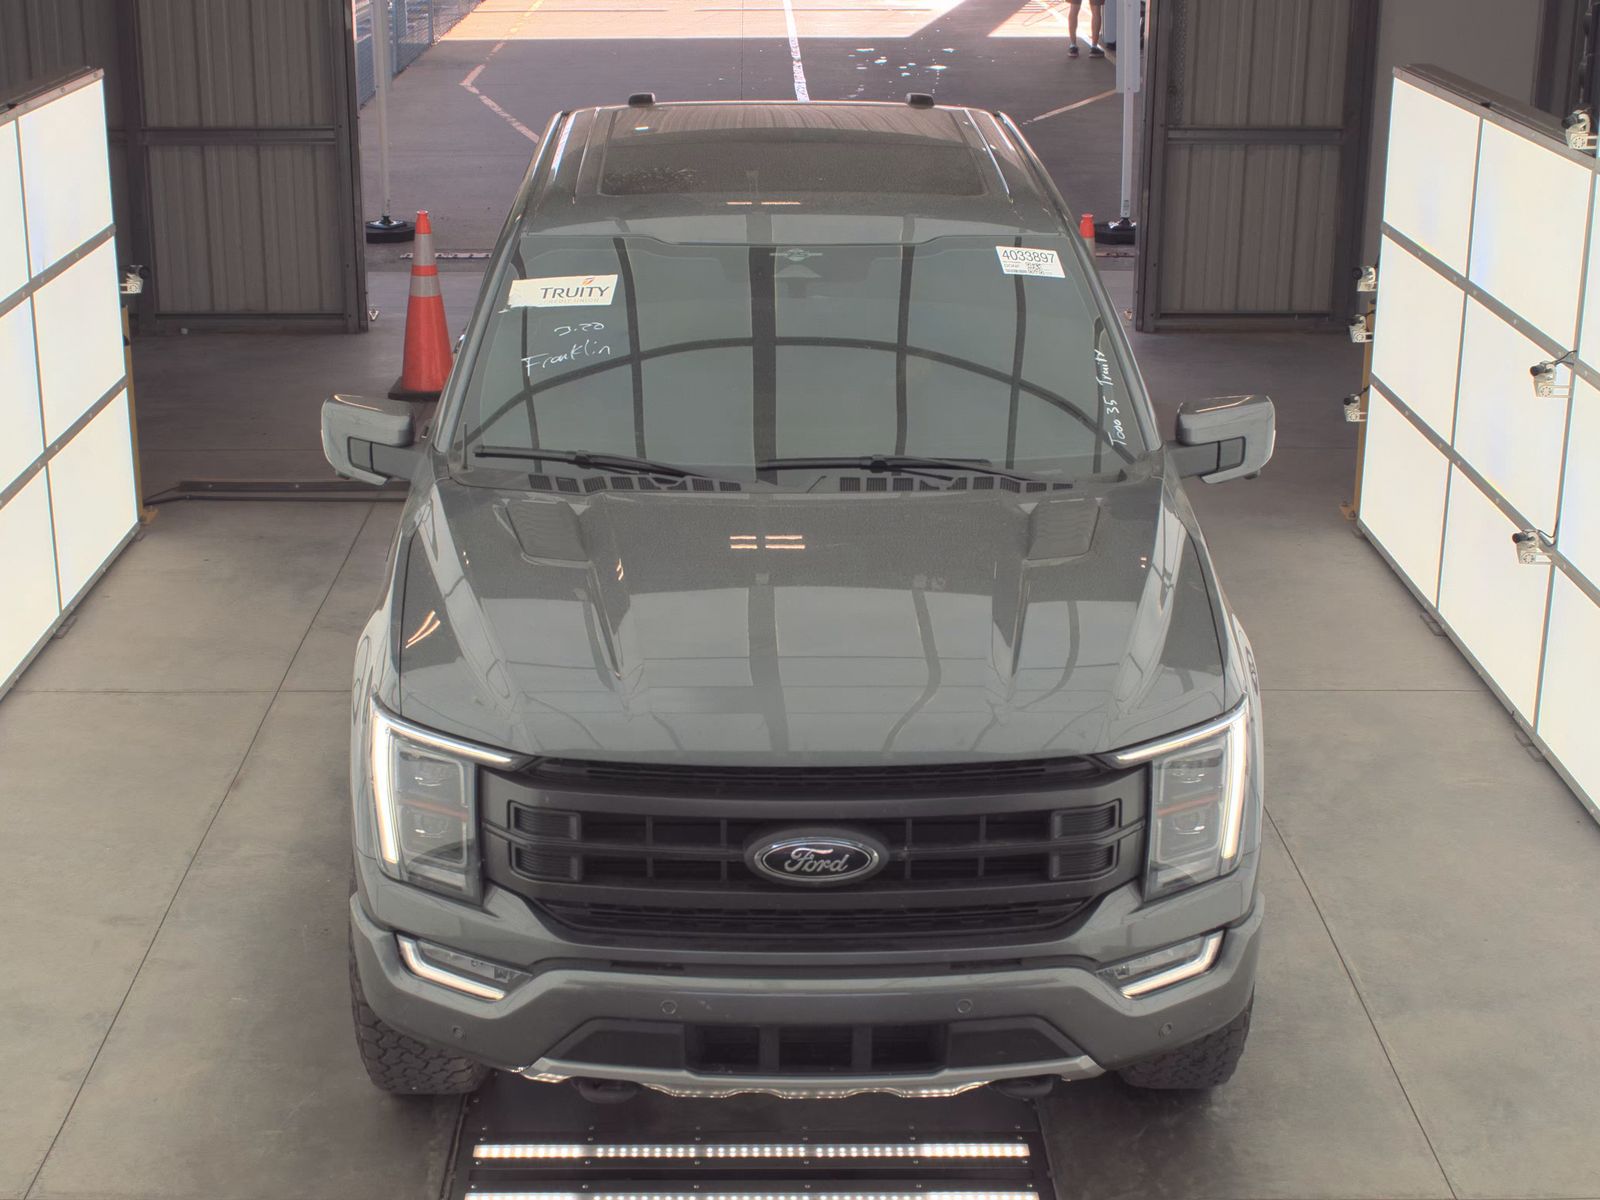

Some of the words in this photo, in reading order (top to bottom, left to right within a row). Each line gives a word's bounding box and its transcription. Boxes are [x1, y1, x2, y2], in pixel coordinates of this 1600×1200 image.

[1002, 249, 1055, 263] 4033897
[541, 286, 610, 299] TRUITY
[521, 339, 611, 377] Franklin
[784, 847, 850, 872] Ford
